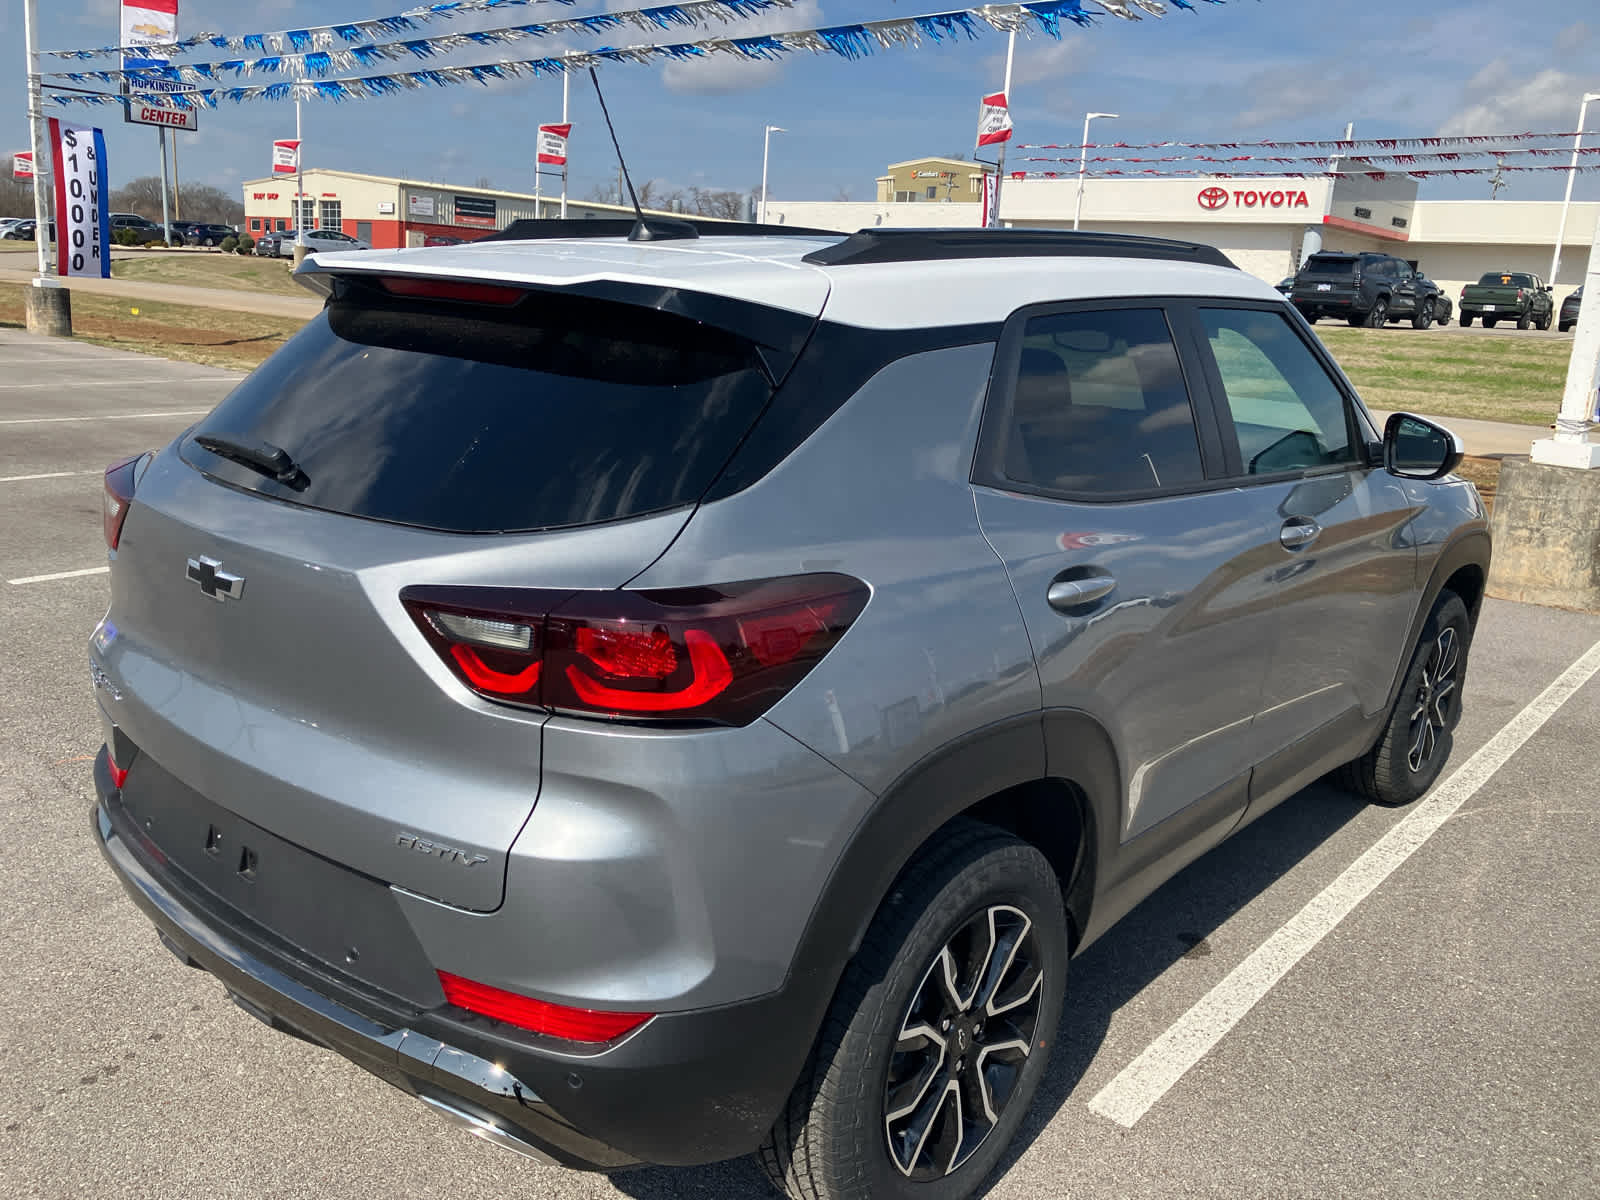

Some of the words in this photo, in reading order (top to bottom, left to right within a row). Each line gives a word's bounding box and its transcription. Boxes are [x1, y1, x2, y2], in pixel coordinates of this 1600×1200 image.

[141, 107, 187, 126] CENTER
[1233, 190, 1309, 208] TOYOTA
[88, 170, 100, 259] UNDER
